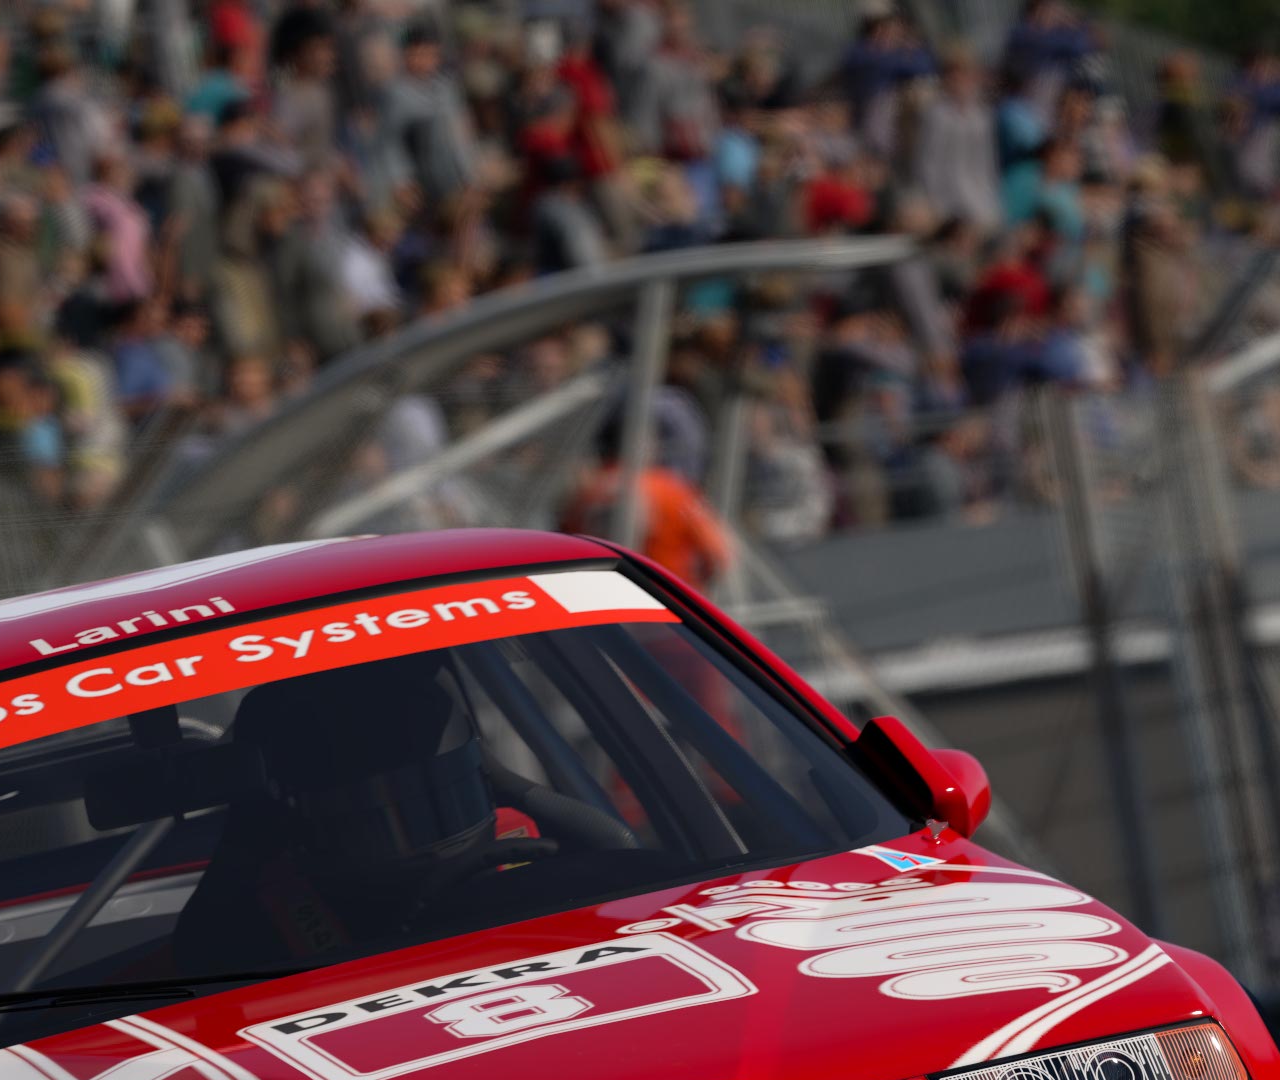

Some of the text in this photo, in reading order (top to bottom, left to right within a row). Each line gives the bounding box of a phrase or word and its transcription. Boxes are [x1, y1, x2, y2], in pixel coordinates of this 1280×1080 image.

[29, 596, 235, 657] Larini
[65, 654, 204, 699] Car
[228, 588, 537, 663] Systems
[270, 945, 653, 1035] DEKRA
[423, 983, 595, 1039] 8
